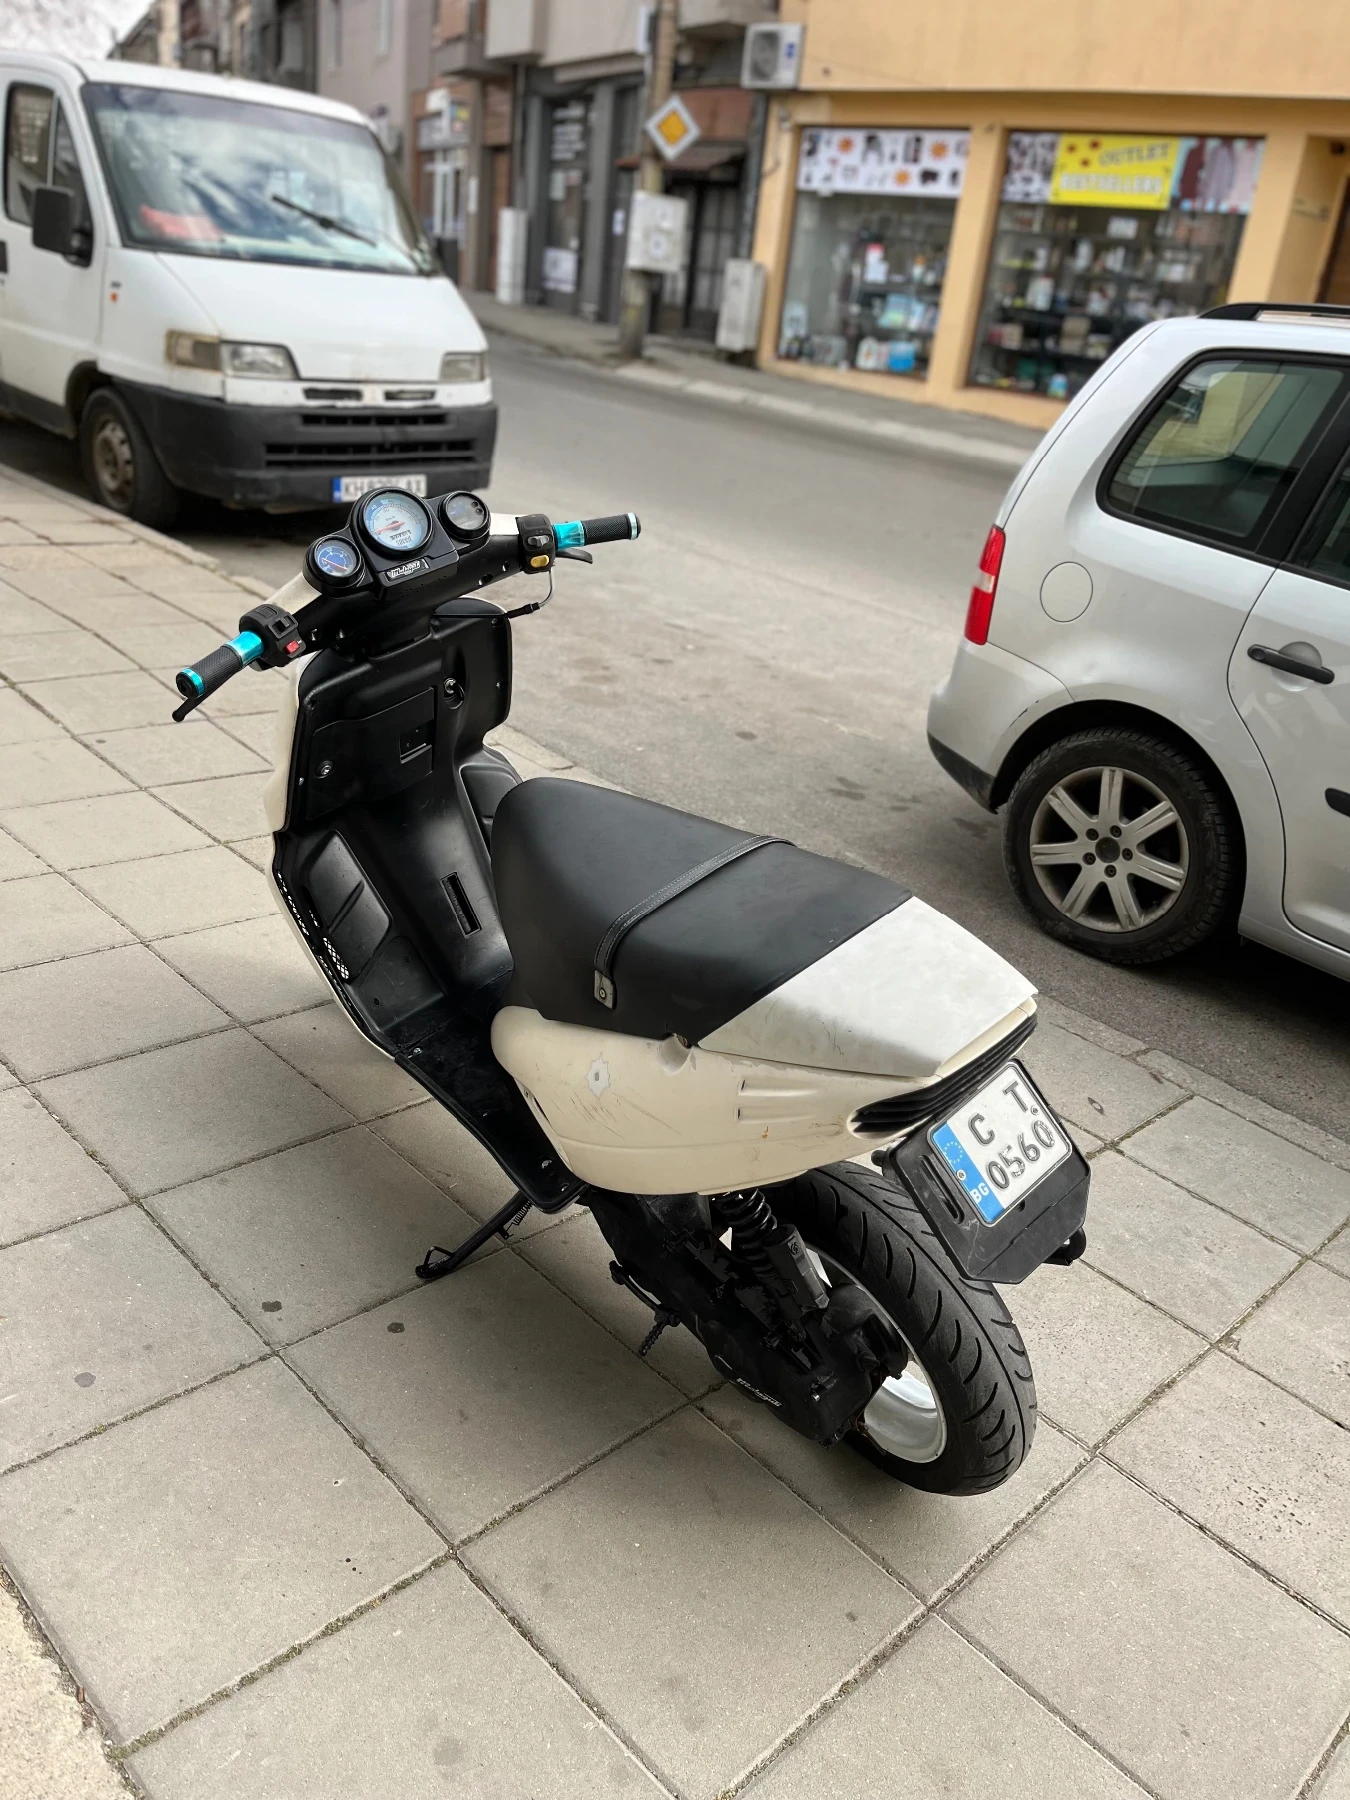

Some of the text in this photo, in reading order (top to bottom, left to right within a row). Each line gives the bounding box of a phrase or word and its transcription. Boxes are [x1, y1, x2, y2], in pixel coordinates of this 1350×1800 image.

[1099, 141, 1170, 167] OUTLET
[1060, 172, 1163, 195] BESTSELLERS
[968, 1080, 1029, 1146] C T
[986, 1120, 1055, 1190] 0560
[970, 1182, 989, 1203] BG
